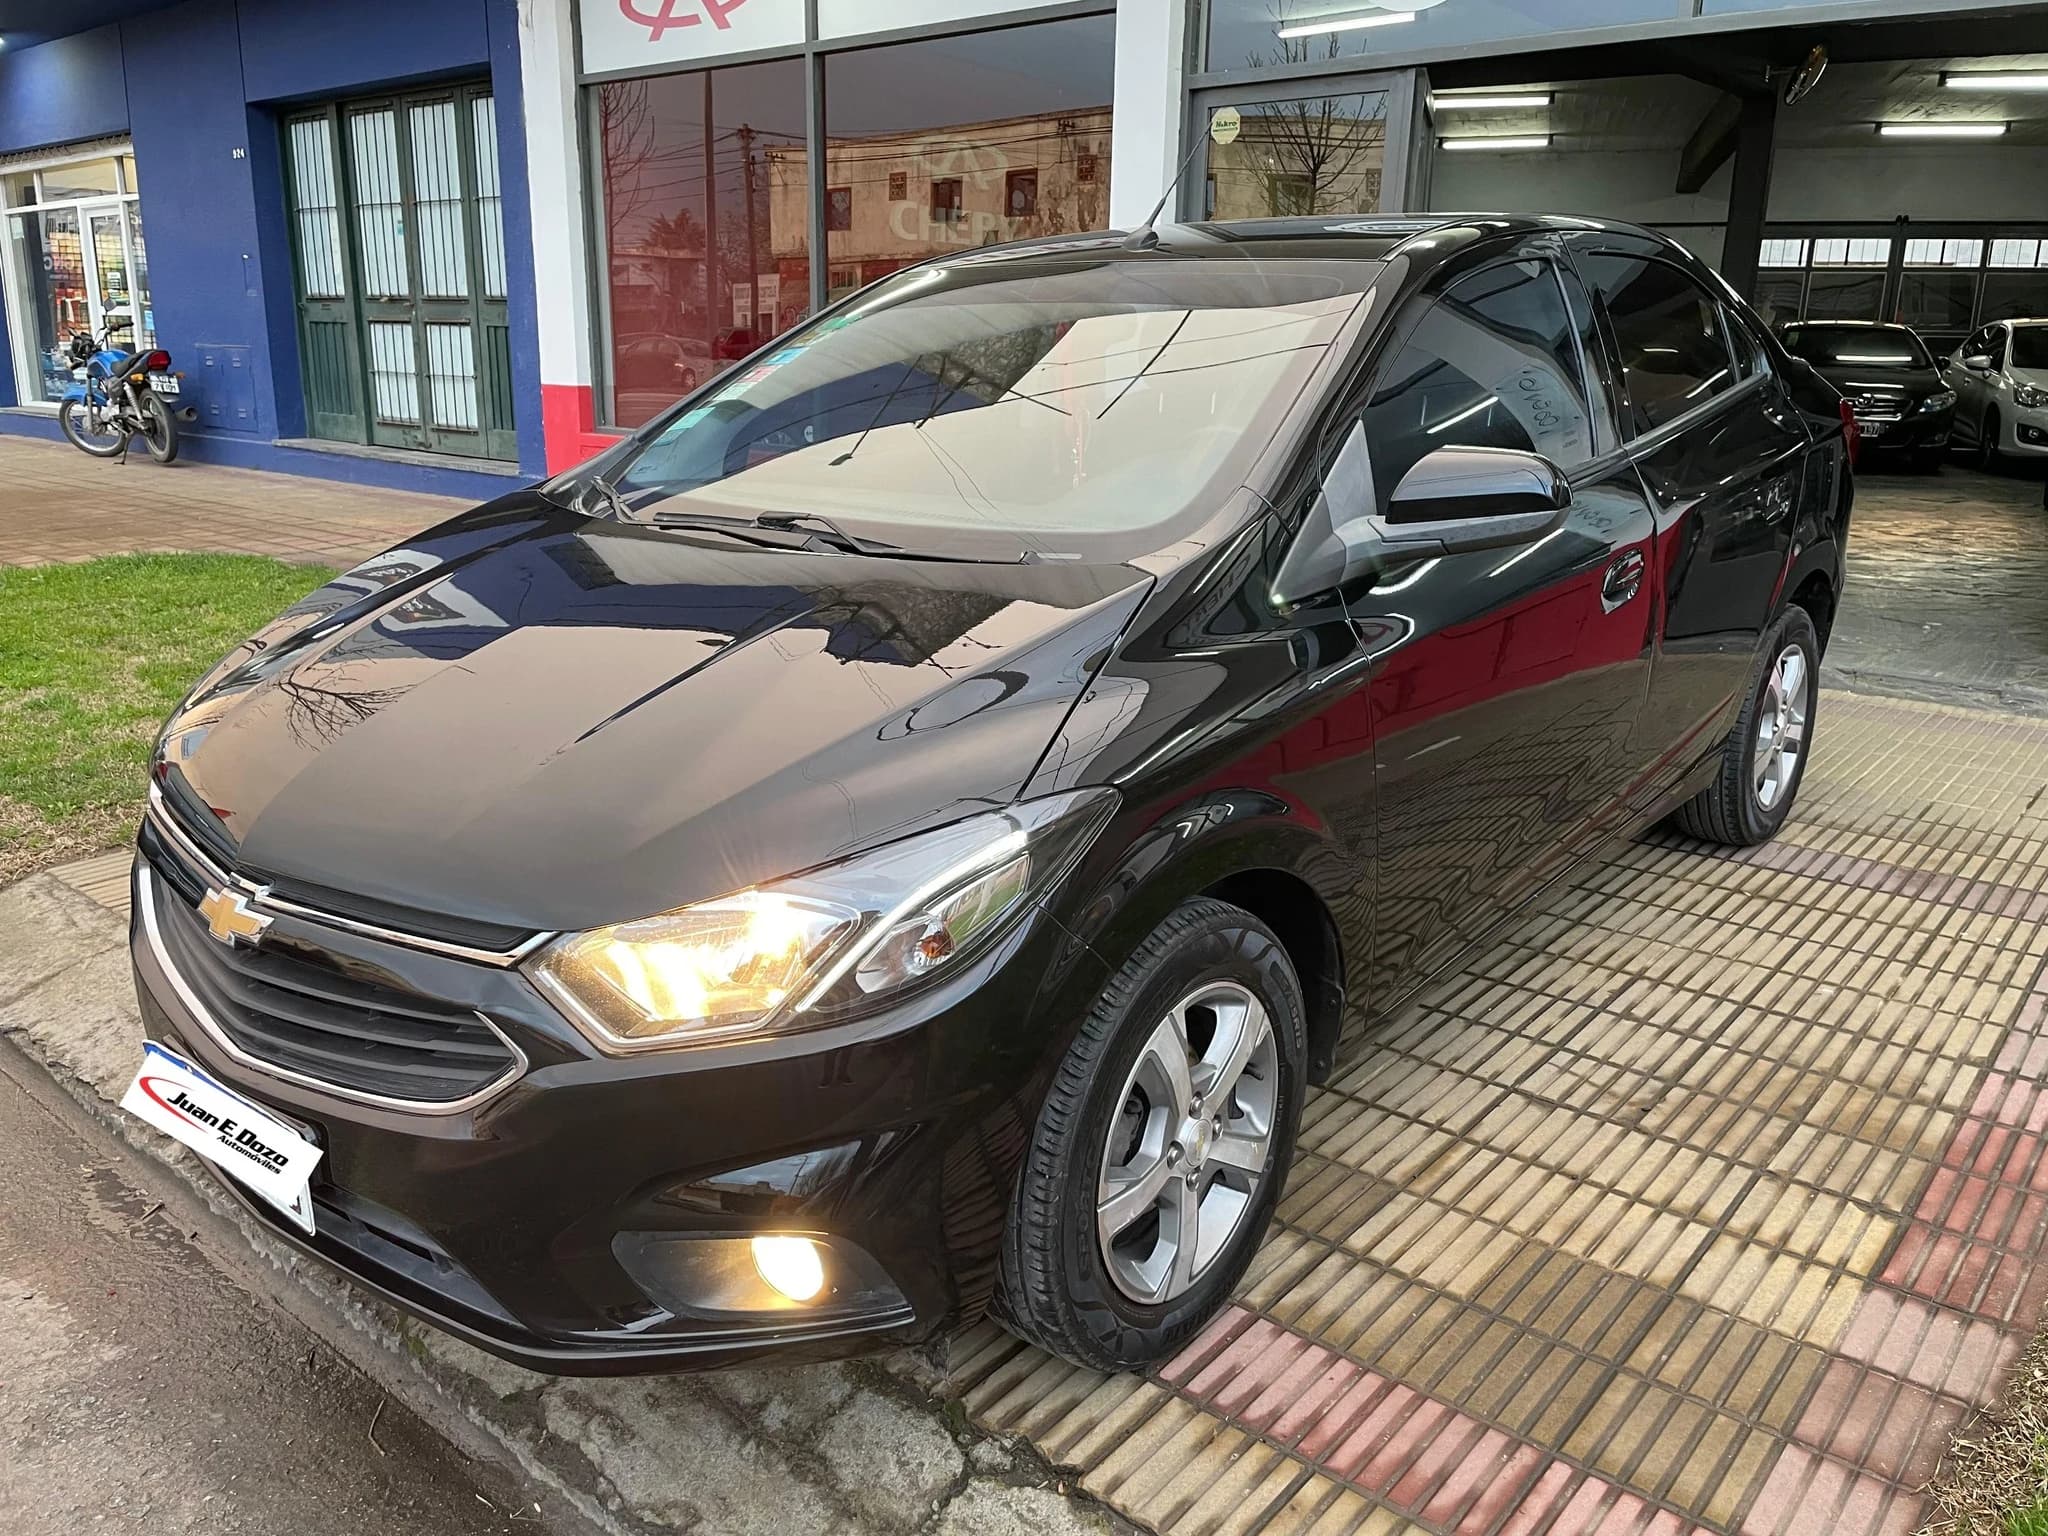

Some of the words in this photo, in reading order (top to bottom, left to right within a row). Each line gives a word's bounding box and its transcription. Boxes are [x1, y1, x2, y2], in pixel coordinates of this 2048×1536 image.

[166, 1092, 219, 1127] Juan
[235, 1128, 289, 1167] Dozo
[216, 1135, 282, 1174] Automóviles
